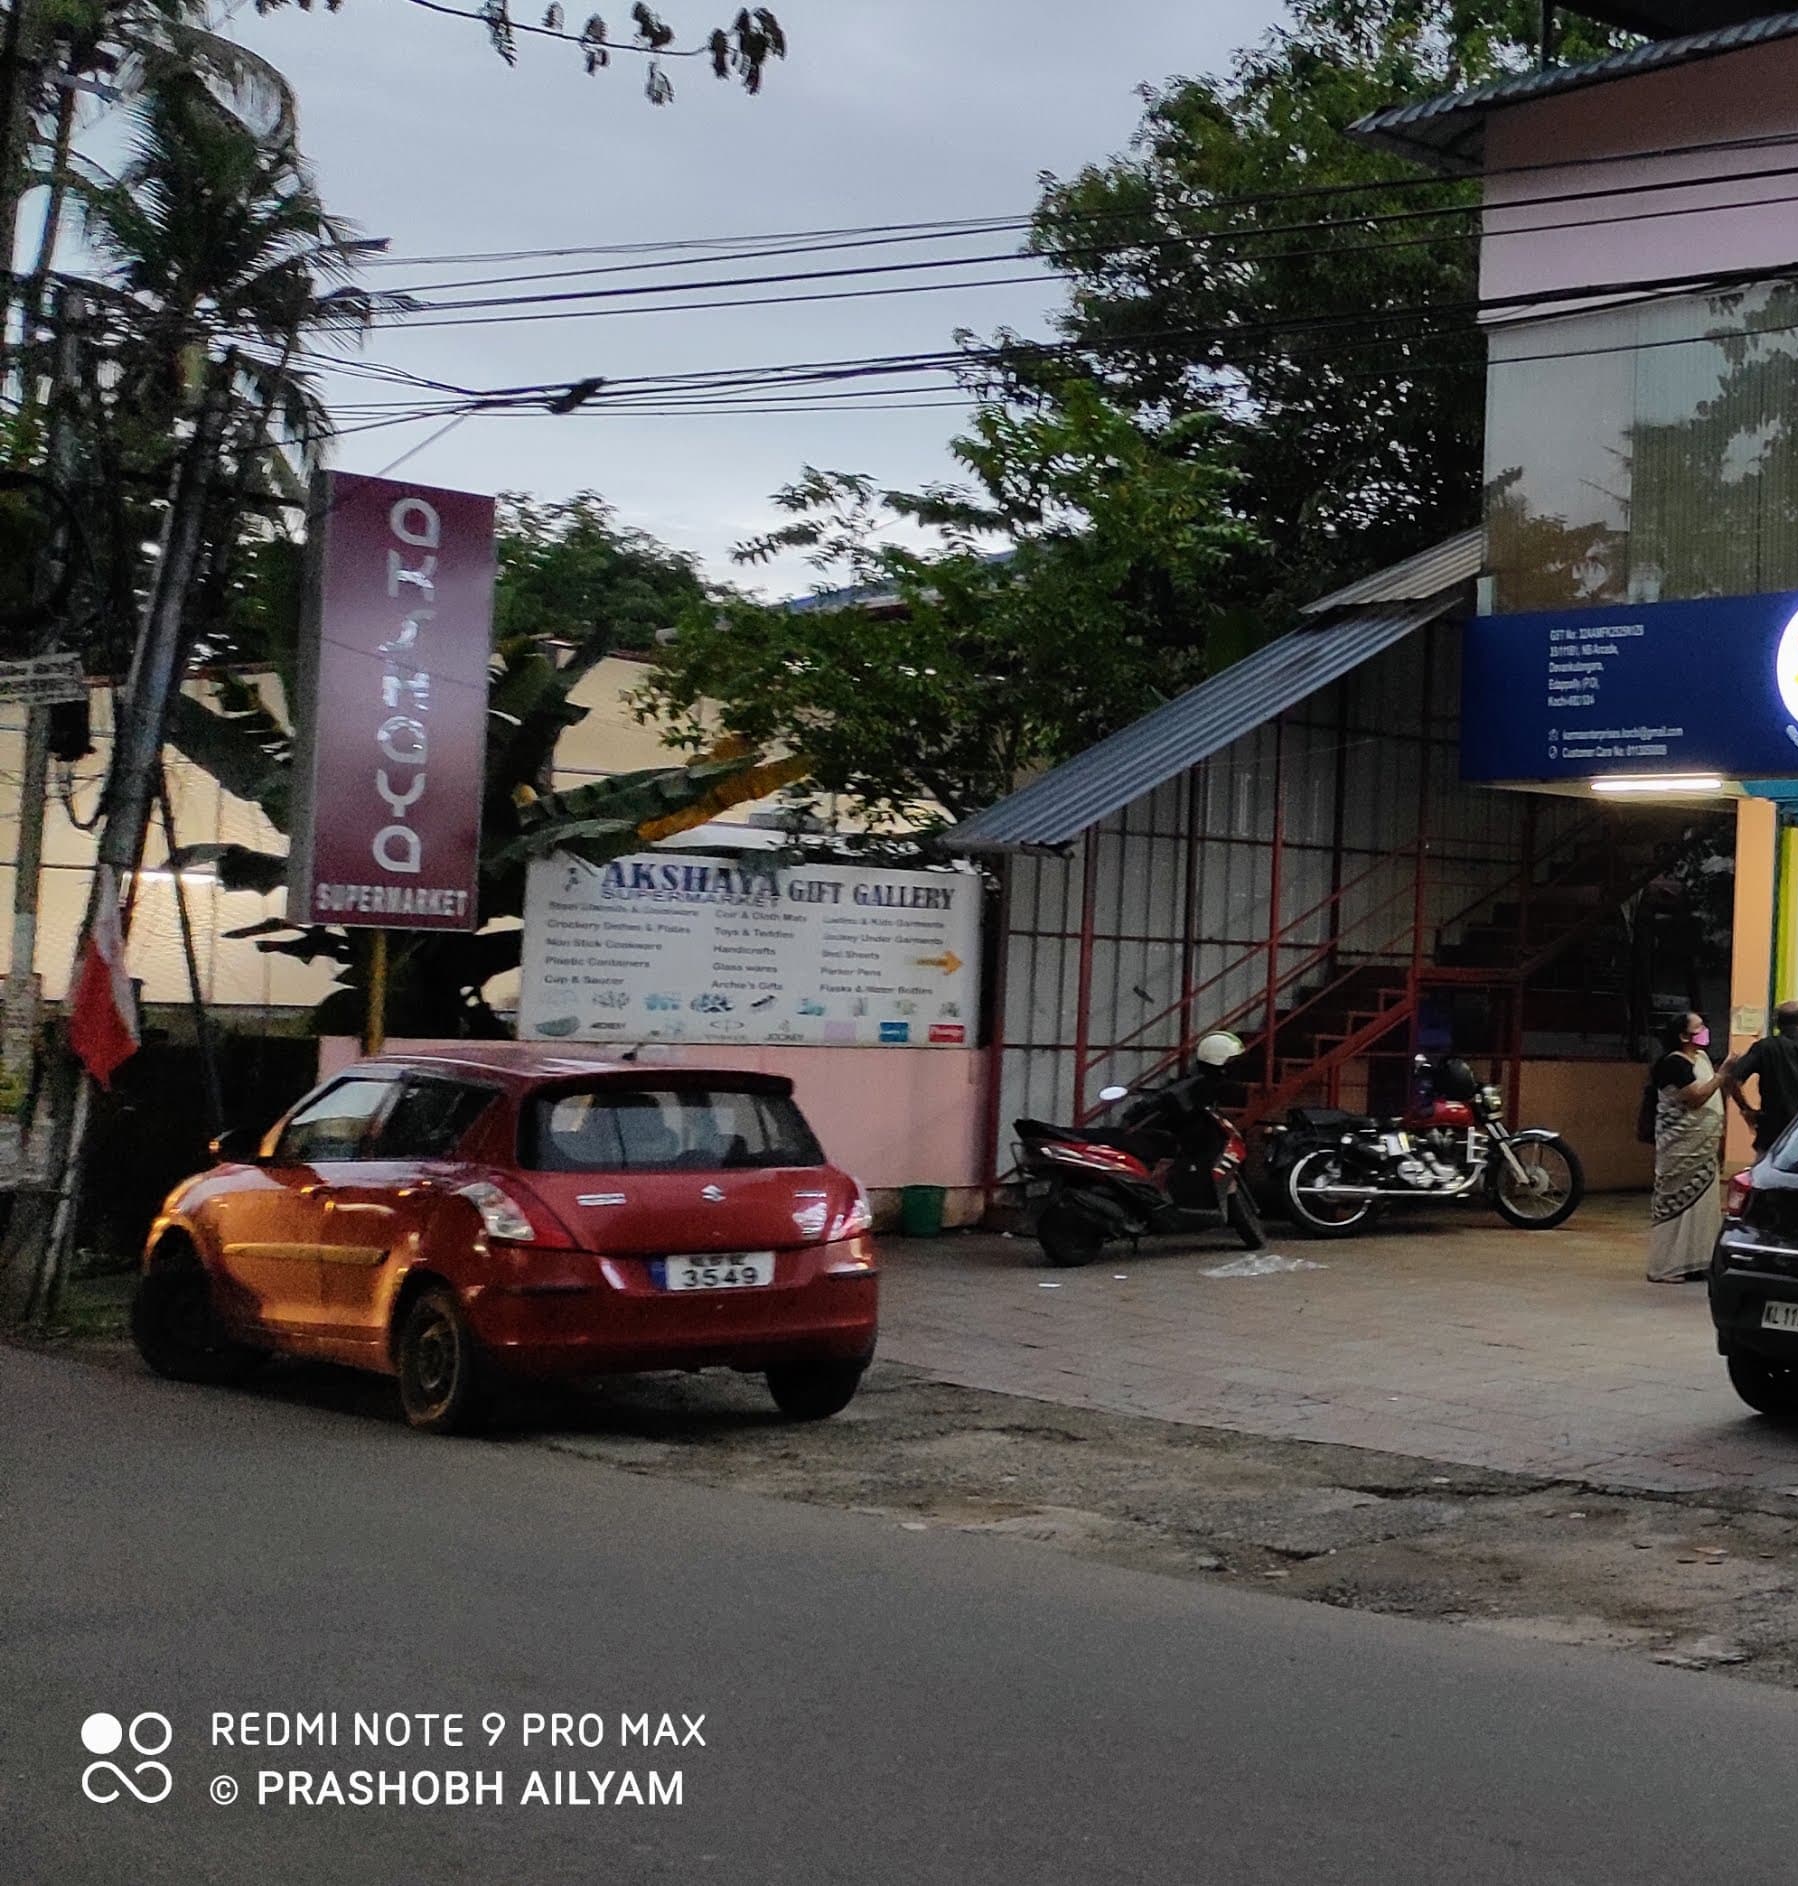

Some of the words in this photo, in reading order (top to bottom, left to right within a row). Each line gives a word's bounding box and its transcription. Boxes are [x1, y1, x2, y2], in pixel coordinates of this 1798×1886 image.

[316, 883, 468, 917] SUPERMARKET
[789, 879, 843, 904] GIFT
[853, 884, 956, 910] GALLERY
[547, 919, 599, 931] Crockery
[714, 927, 740, 939] Toys
[742, 928, 751, 938] &
[713, 945, 777, 957] Handicrafts
[712, 962, 744, 973] Glass
[544, 975, 569, 986] Cup
[757, 981, 784, 992] Gifts
[765, 1033, 805, 1042] JOCKEY
[681, 1266, 760, 1287] 3549
